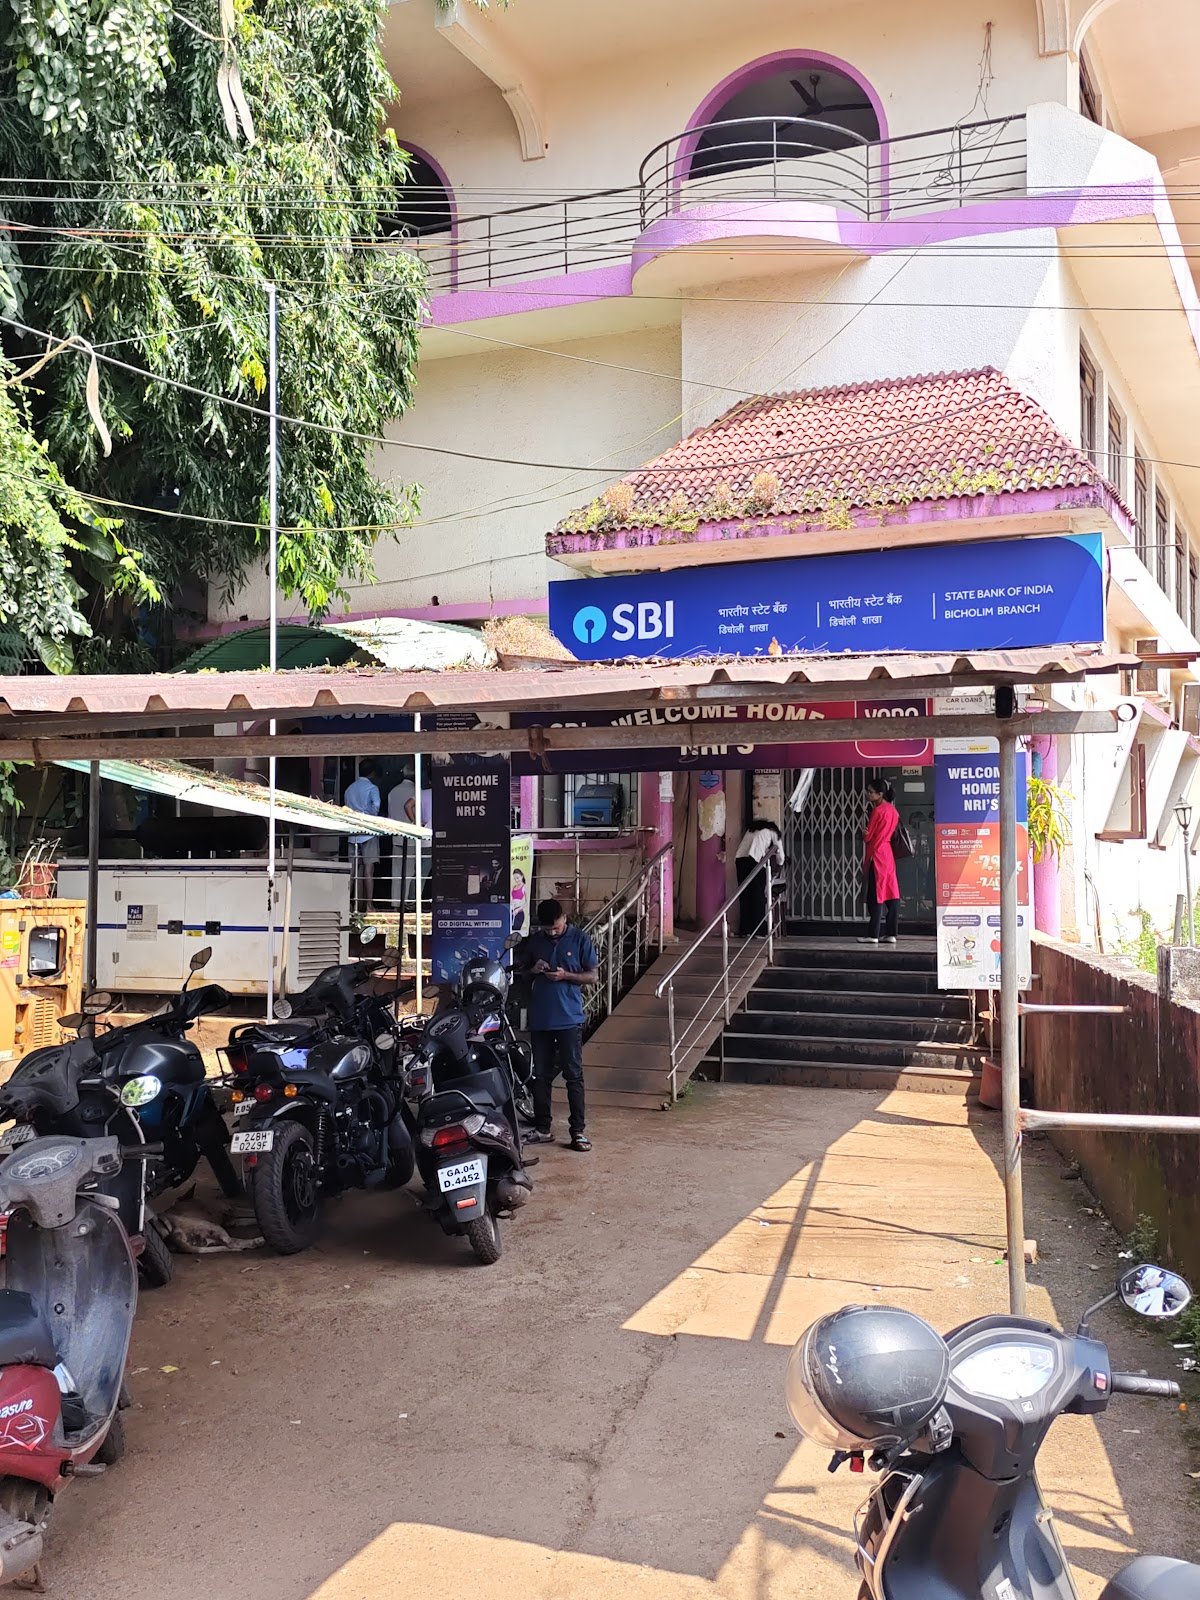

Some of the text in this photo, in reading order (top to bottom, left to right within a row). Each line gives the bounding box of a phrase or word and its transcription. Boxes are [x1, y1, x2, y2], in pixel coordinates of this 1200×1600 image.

[944, 584, 1054, 601] STATE BANK OF INDIA
[828, 596, 861, 610] भारतीय
[863, 594, 884, 607] स्टेट
[718, 604, 749, 618] भारतीय
[751, 602, 771, 615] स्टेट
[944, 604, 1040, 619] BICHOLIM BRANCH
[611, 600, 674, 642] SBI
[829, 615, 882, 628] डिचोली शाखा
[718, 623, 769, 635] डिचोली शाखा
[443, 775, 499, 787] WELCOME
[454, 790, 487, 801] HOME
[961, 783, 1000, 795] HOME
[456, 805, 486, 817] NRI'S
[964, 798, 999, 811] NRI'S
[245, 1133, 266, 1142] 24BH
[240, 1141, 267, 1151] 0249F
[446, 1163, 475, 1177] GA.04
[443, 1172, 480, 1188] D.4452
